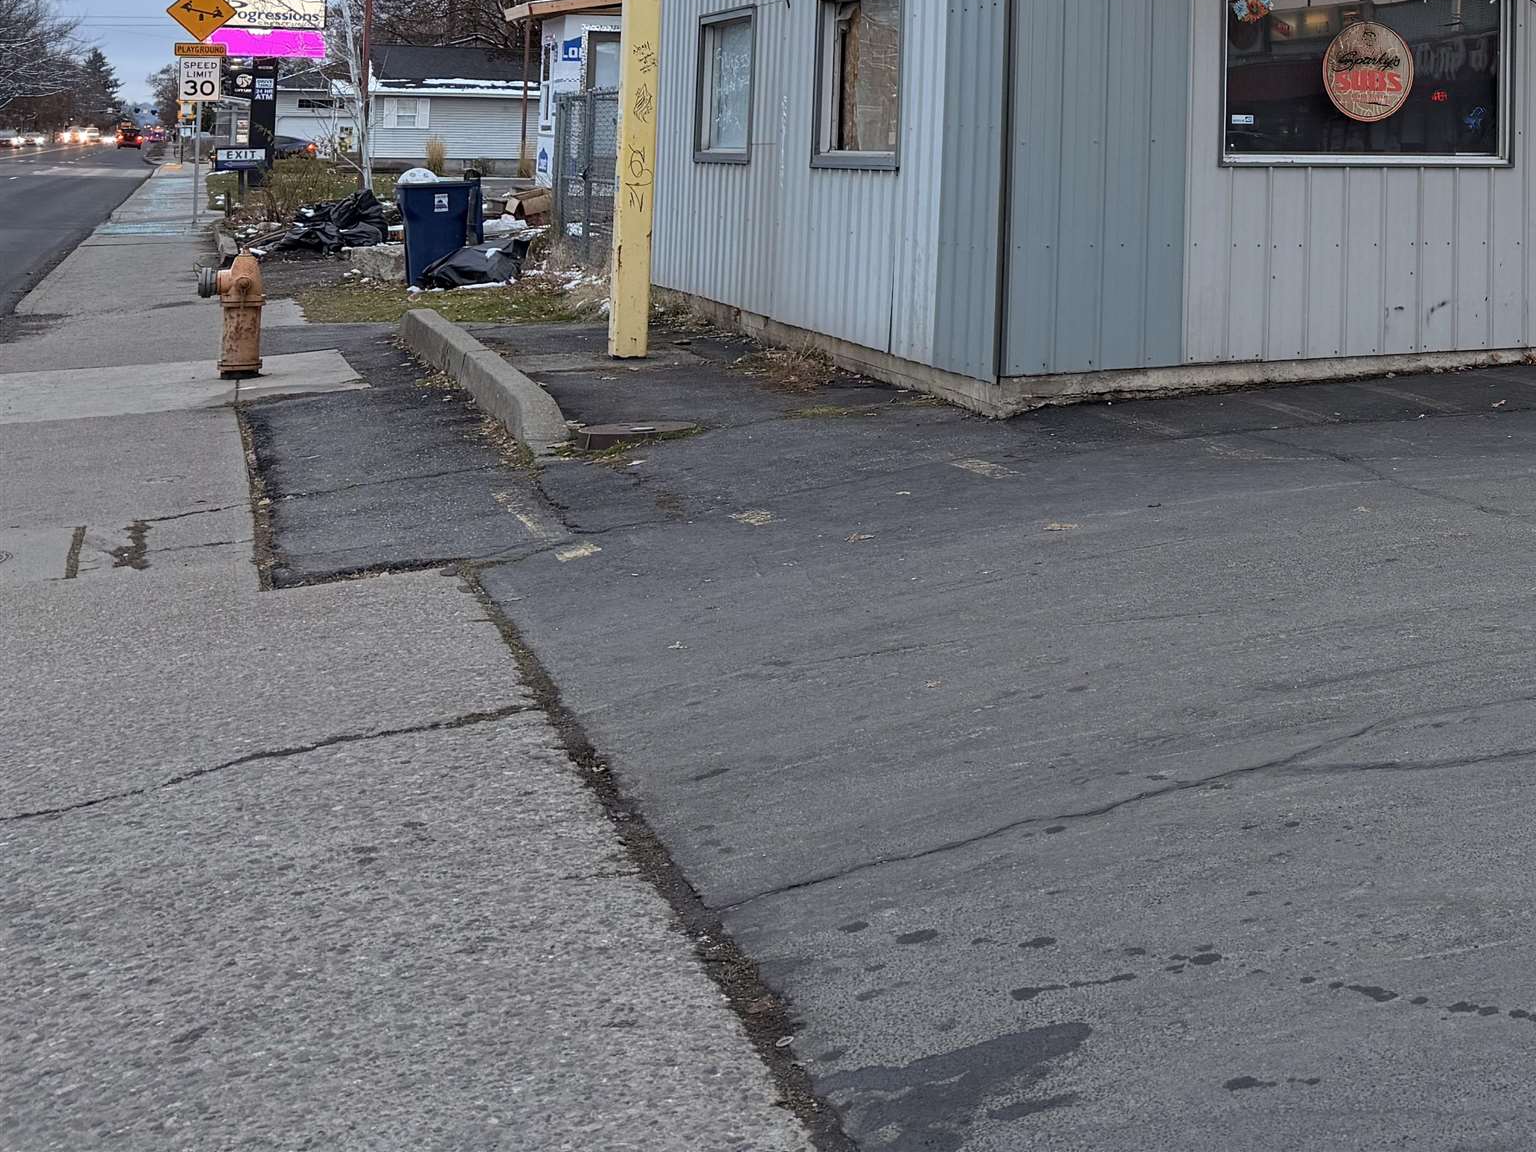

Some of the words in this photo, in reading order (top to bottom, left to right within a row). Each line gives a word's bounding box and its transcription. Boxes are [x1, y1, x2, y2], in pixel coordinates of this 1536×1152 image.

[177, 45, 224, 54] PLAYGROUND
[183, 61, 217, 69] SPEED
[1332, 51, 1400, 72] Sparky's
[184, 80, 215, 96] 30
[1334, 69, 1403, 94] SUBS
[226, 150, 256, 160] EXIT
